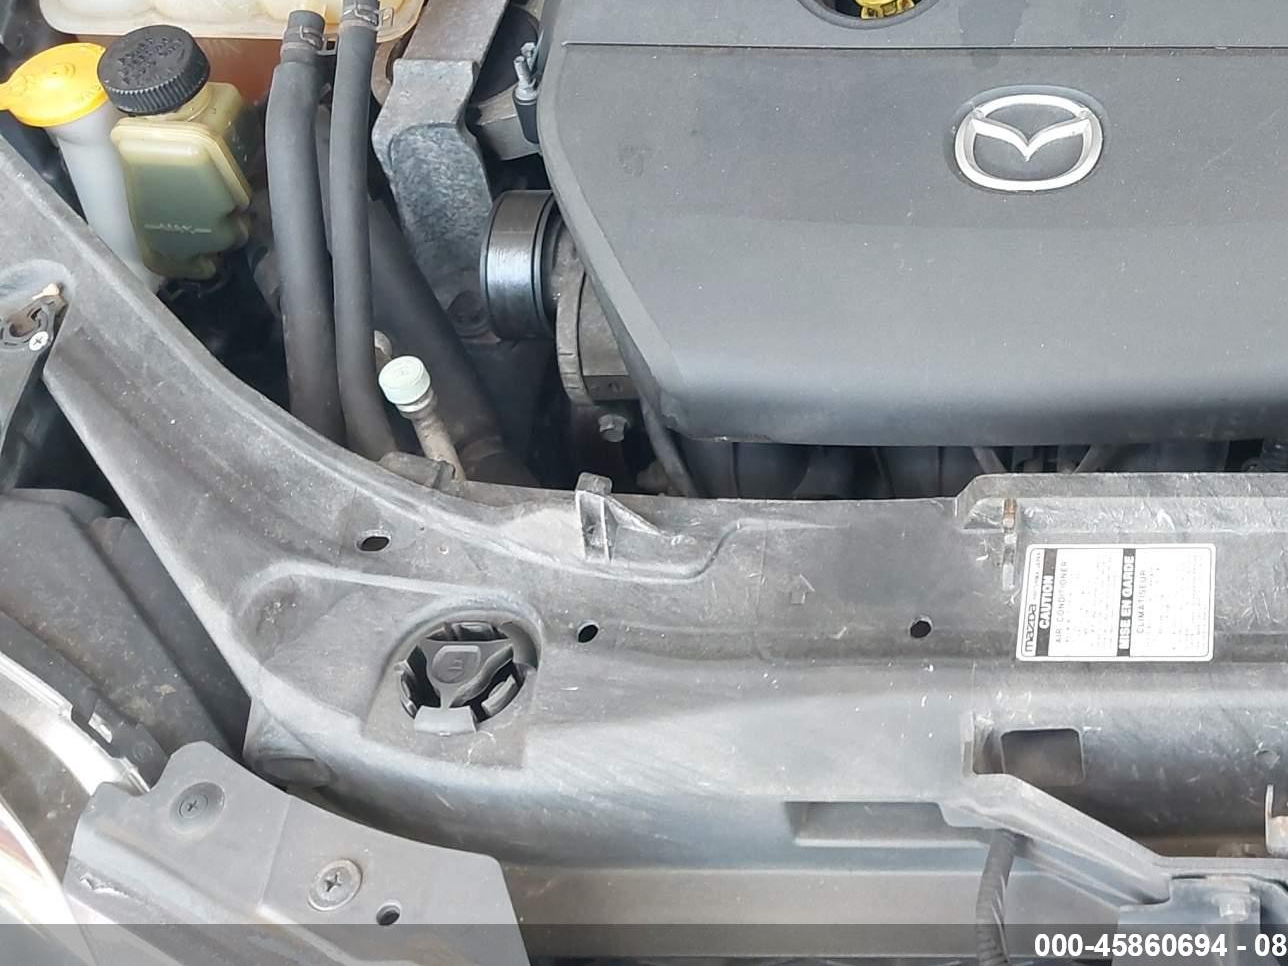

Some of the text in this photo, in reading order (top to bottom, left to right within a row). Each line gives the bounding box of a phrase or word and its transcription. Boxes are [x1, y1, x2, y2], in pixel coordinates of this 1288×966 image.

[1039, 575, 1055, 630] CAUTION
[1055, 561, 1068, 643] AIR CONDITIONER
[1118, 555, 1136, 650] MISE EN GARDE
[1136, 570, 1147, 634] CLIMATISEUR
